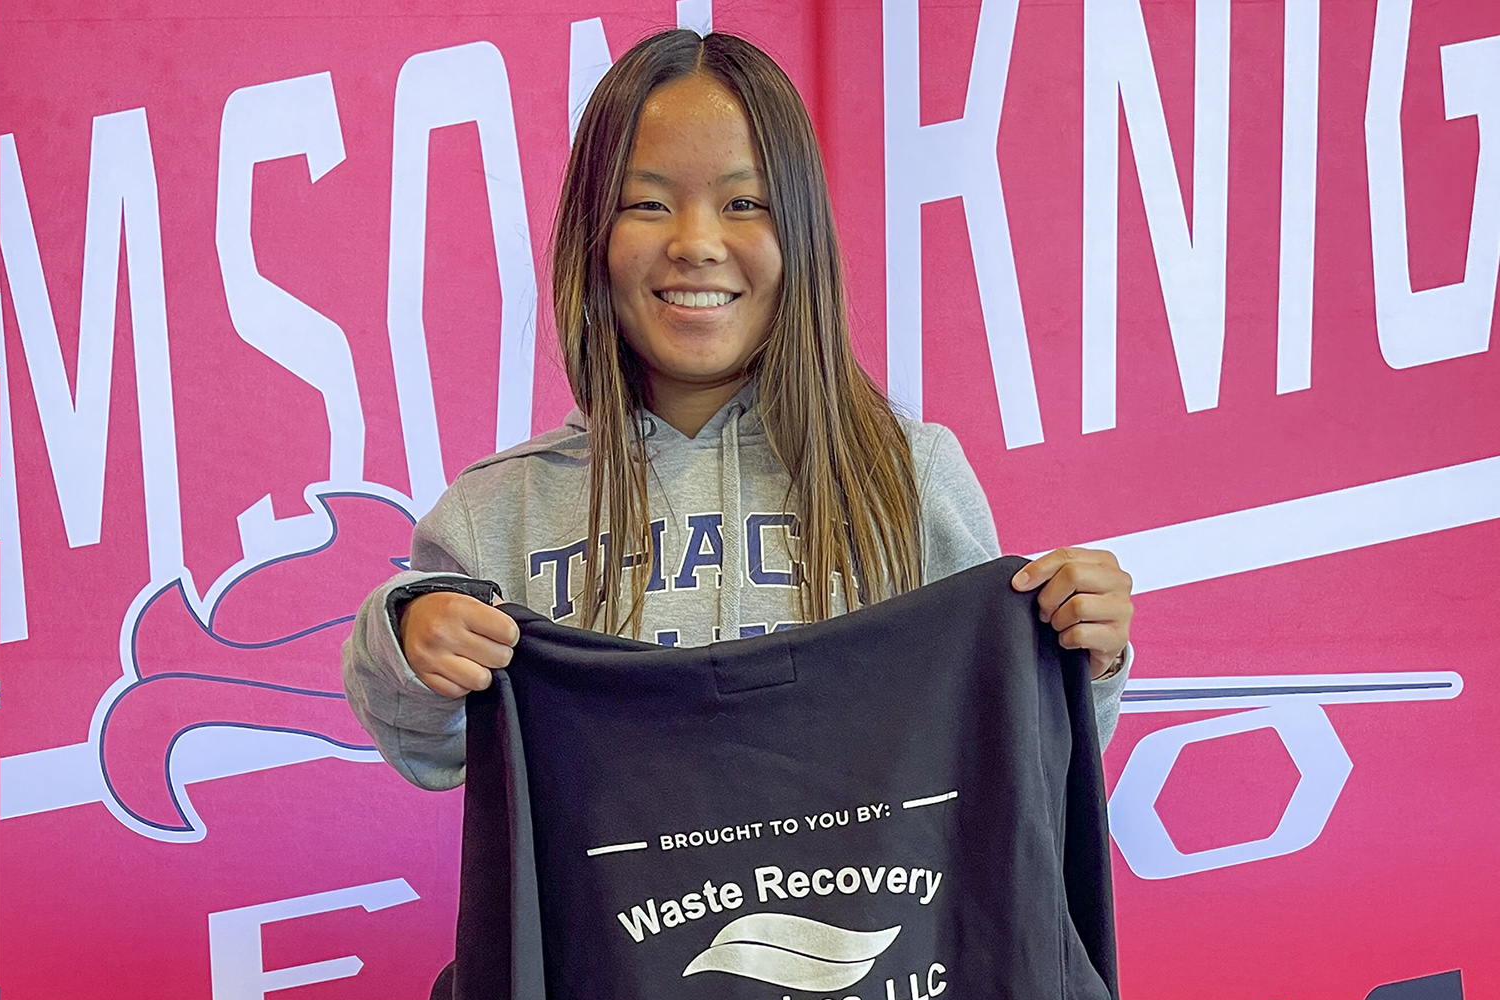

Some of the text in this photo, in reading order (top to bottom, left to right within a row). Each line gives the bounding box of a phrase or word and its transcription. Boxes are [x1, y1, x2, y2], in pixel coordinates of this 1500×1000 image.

[0, 0, 712, 643] MSO
[660, 802, 892, 850] BROUGHT TO YOU BY:
[617, 865, 943, 943] Waste Recovery
